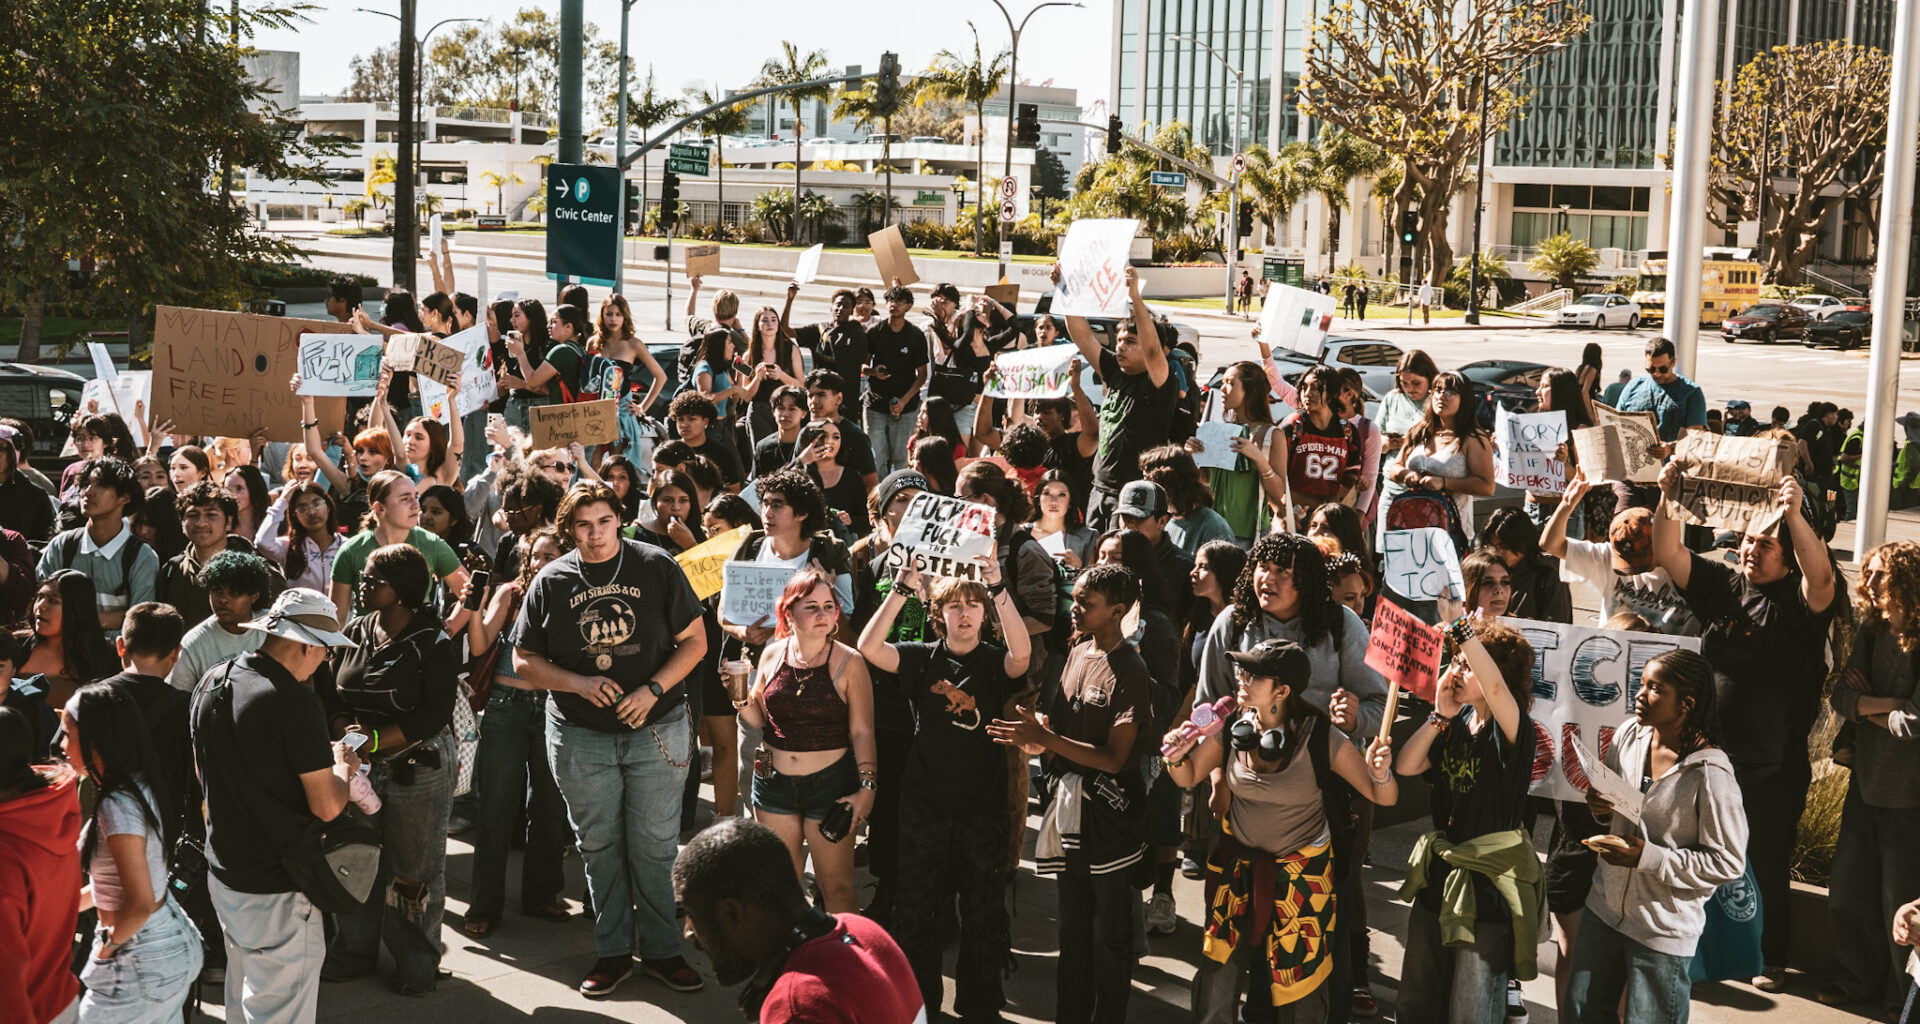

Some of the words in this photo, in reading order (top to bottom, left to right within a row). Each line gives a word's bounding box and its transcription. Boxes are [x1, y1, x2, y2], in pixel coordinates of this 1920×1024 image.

[677, 160, 693, 171] Queen
[694, 163, 707, 173] Mary
[1156, 174, 1173, 183] Ocean
[555, 207, 578, 221] Civic
[580, 208, 614, 224] Center
[1089, 256, 1118, 308] ICE
[164, 310, 268, 347] WHAT
[168, 343, 245, 377] LAND
[302, 340, 355, 384] FUCK
[169, 377, 238, 405] FREE
[247, 387, 300, 410] TRUL
[1295, 442, 1348, 458] SPIDER-MAN
[1305, 452, 1340, 481] 62
[1526, 458, 1540, 468] IF
[1546, 458, 1563, 478] NO
[1508, 472, 1552, 490] SPEAKS
[907, 494, 966, 524] FUCK
[957, 505, 992, 537] ICE
[920, 522, 963, 548] FUCK
[929, 543, 948, 555] THE
[728, 574, 742, 586] I
[744, 571, 774, 586] Like
[569, 590, 588, 609] LEVI
[588, 583, 622, 599] STRAUSS
[621, 586, 629, 595] &
[629, 586, 641, 599] CO
[744, 587, 774, 600] ICE
[731, 601, 776, 616] CRUSH
[1376, 617, 1390, 634] DUE
[1392, 626, 1435, 658] PROCESS
[1380, 604, 1409, 630] PRISON
[1411, 622, 1441, 649] WITHOUT
[1371, 635, 1434, 677] CONCENTRATION
[1392, 639, 1401, 649] IS
[1404, 645, 1412, 656] A
[1384, 655, 1412, 677] CAMP
